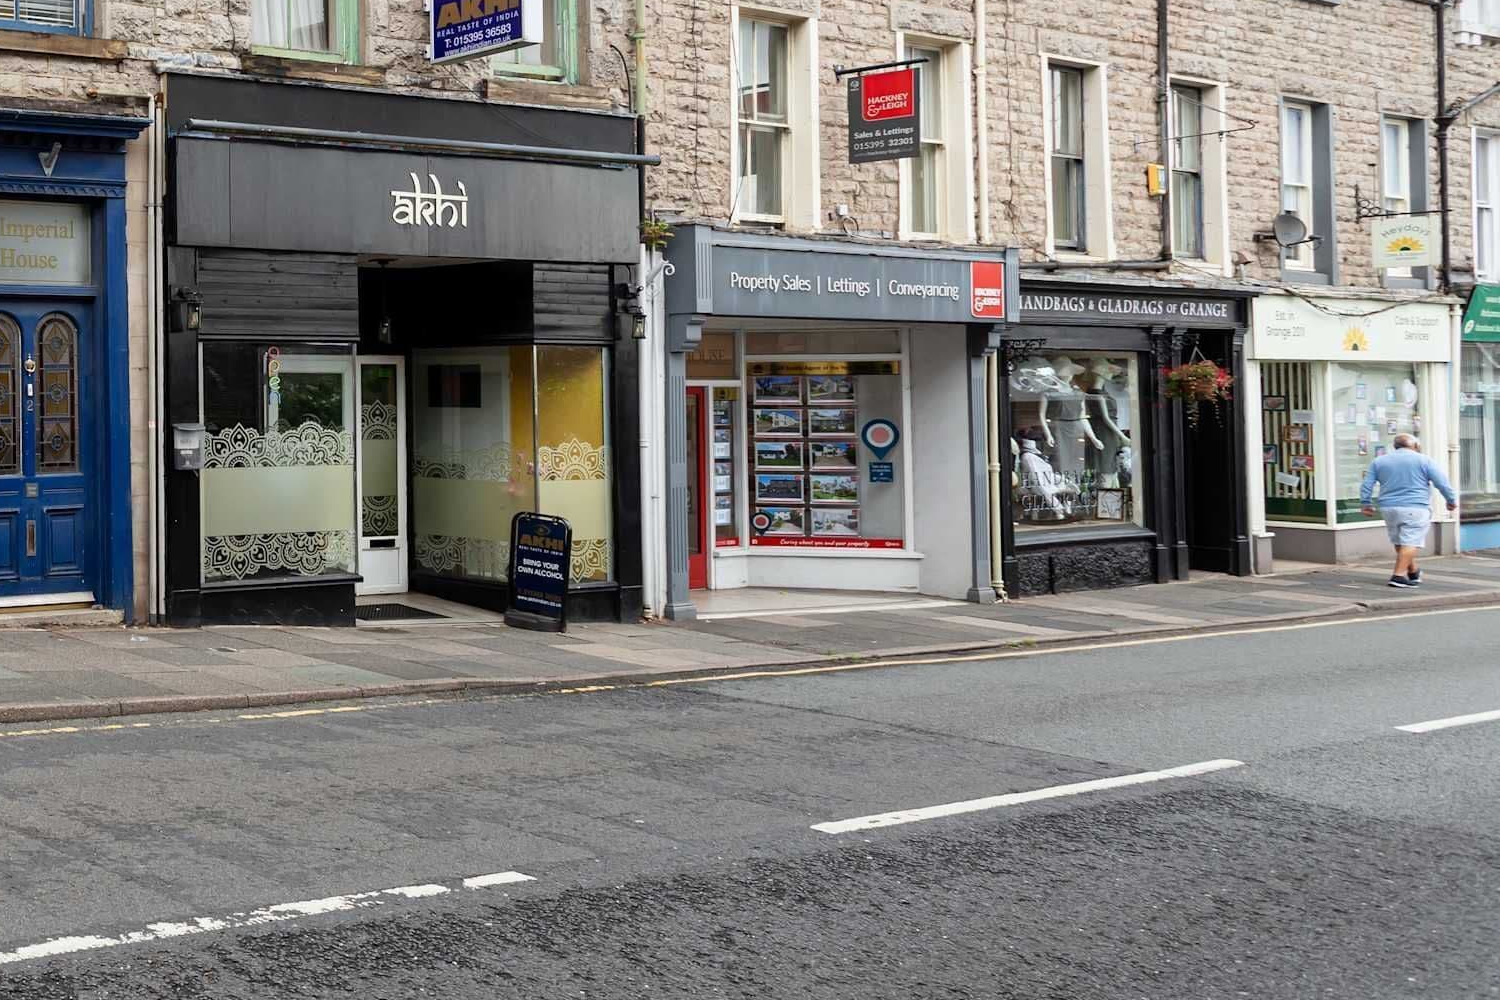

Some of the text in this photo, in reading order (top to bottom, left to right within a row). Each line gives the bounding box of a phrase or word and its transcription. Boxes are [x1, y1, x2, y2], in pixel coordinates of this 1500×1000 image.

[437, 10, 519, 38] REAL TASTE OF INDIA
[453, 30, 484, 47] 015395
[485, 23, 511, 39] 36583
[868, 92, 909, 105] HACKNEY
[883, 100, 907, 110] LEIGH
[854, 131, 873, 139] Sales
[883, 126, 913, 136] Lettings
[854, 137, 913, 150] 015395 32301
[390, 172, 468, 228] akhi
[0, 217, 76, 242] Imperial
[0, 248, 58, 269] House
[730, 272, 959, 301] Property Sales Lettings Conveyancing
[1088, 301, 1094, 310] &
[1098, 298, 1163, 315] GLADRAGS
[1180, 302, 1227, 317] GRANGE
[268, 346, 281, 405] open
[26, 400, 34, 411] 2
[518, 565, 564, 580] OWN ALCOHOL
[523, 558, 559, 571] BRING YOUR
